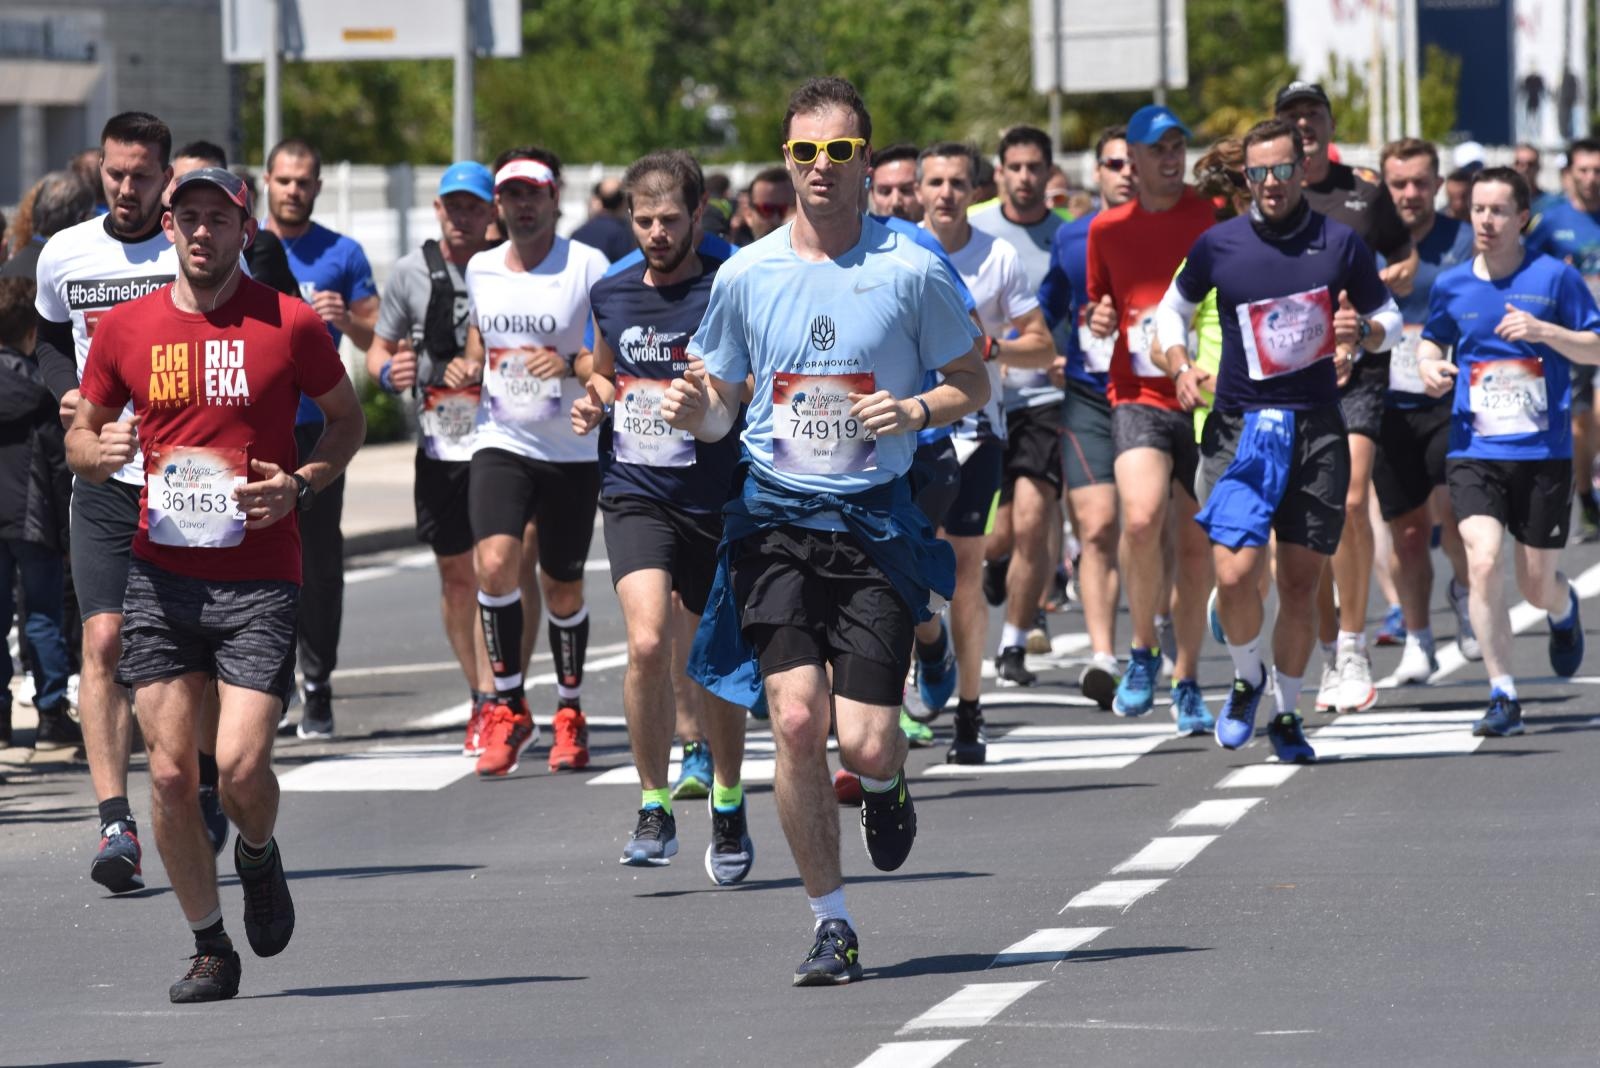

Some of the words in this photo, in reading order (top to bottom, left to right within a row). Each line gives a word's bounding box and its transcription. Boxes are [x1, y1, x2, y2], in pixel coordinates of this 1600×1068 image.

[70, 280, 167, 304] #bašmebri
[480, 314, 556, 334] DOBRO
[205, 340, 244, 368] RIJ
[672, 362, 689, 371] CROA
[804, 359, 859, 369] ORAHOVICA
[205, 368, 250, 397] EKA
[505, 380, 541, 396] 1640
[206, 398, 250, 406] TRAIL
[790, 419, 857, 439] 74919
[813, 447, 833, 457] Ivan
[162, 490, 227, 513] 36153
[179, 520, 206, 529] Davor
